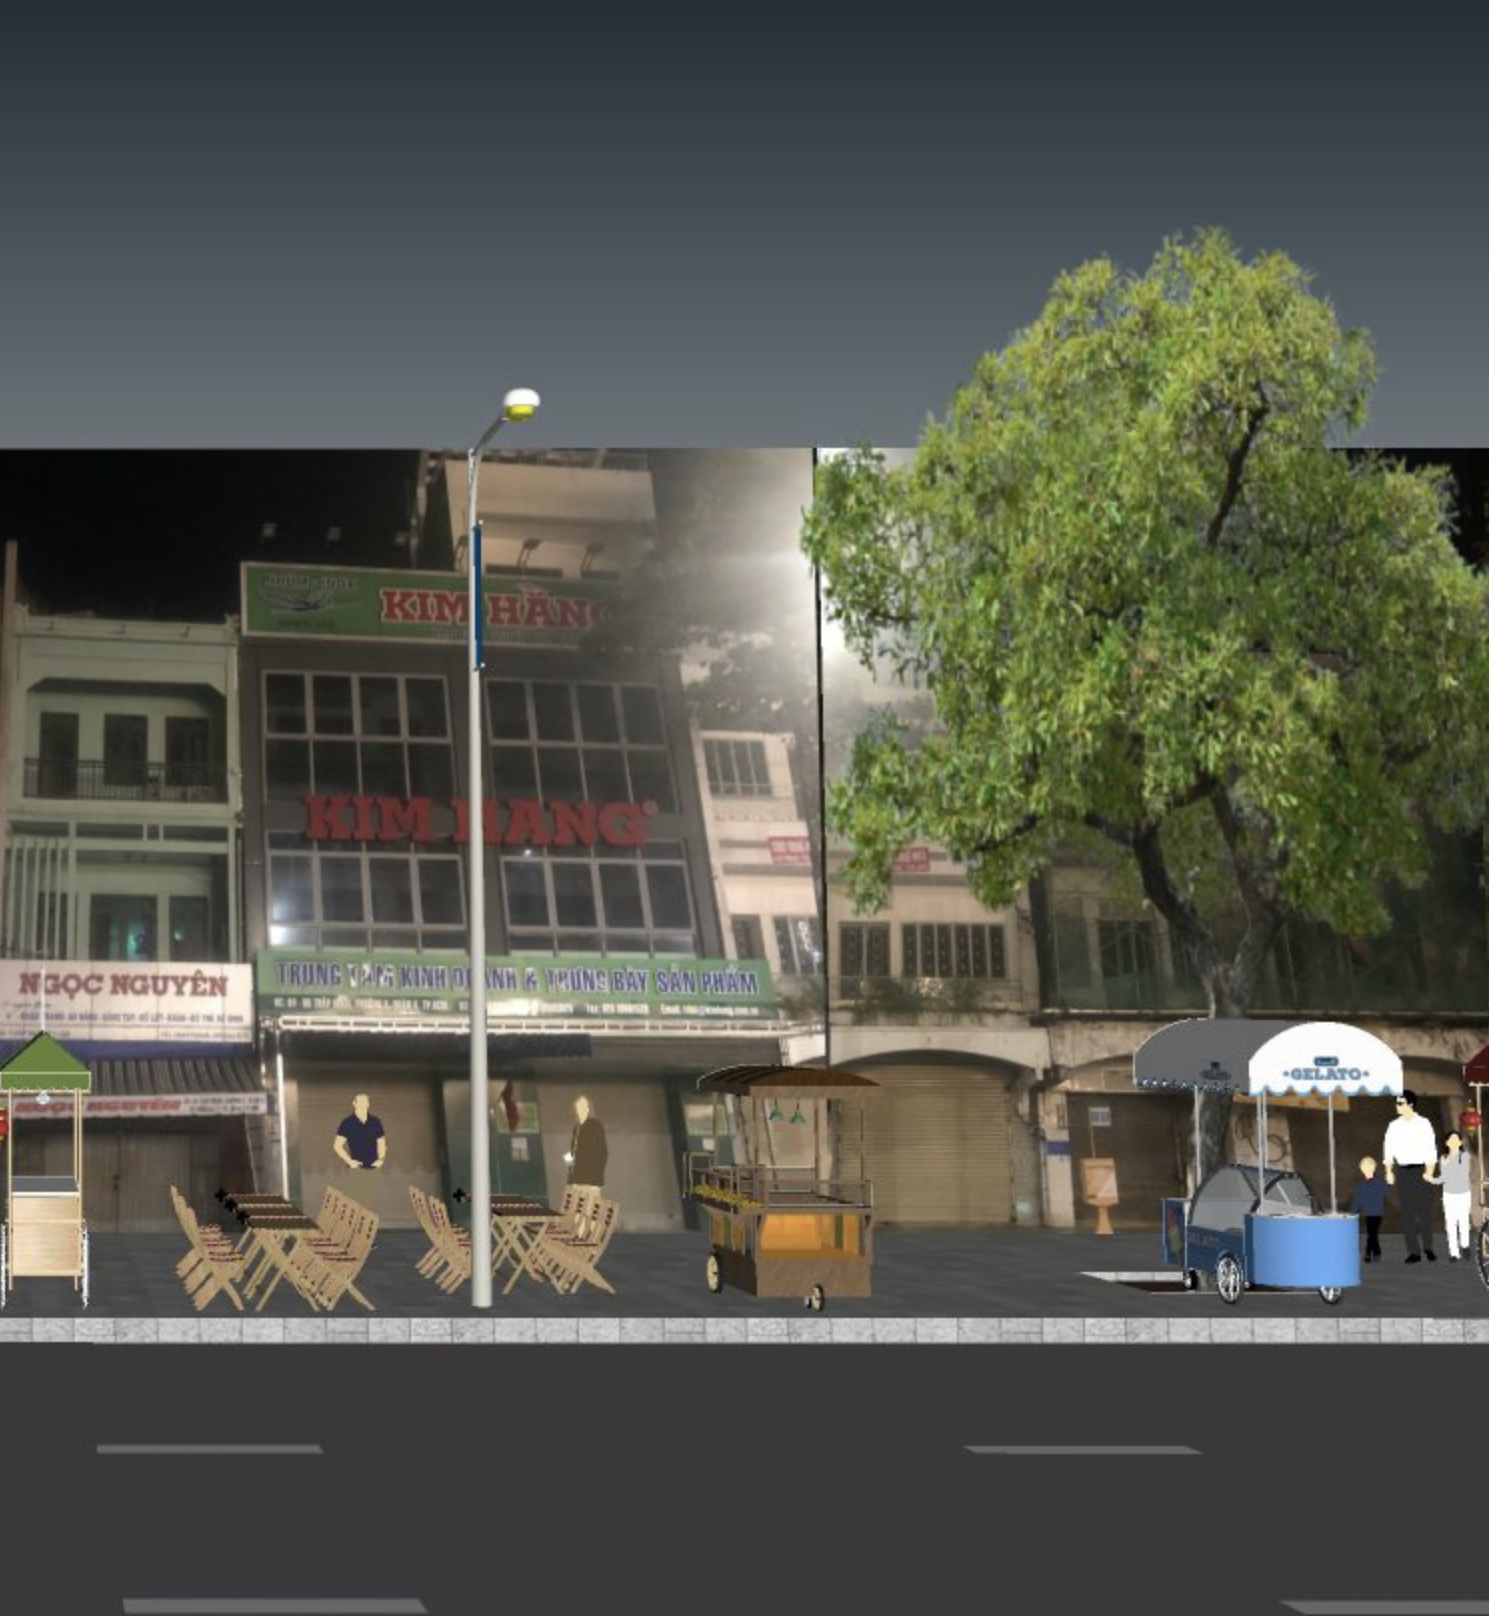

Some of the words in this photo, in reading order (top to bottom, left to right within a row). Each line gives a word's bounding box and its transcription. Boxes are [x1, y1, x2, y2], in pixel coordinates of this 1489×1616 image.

[379, 588, 468, 624] KIM
[306, 796, 433, 840] KIM
[19, 973, 104, 1000] NGỌC
[109, 969, 228, 997] NGUYÊN
[277, 962, 342, 988] TRUNG
[400, 965, 447, 989] KINH
[1290, 1067, 1362, 1081] GELATO
